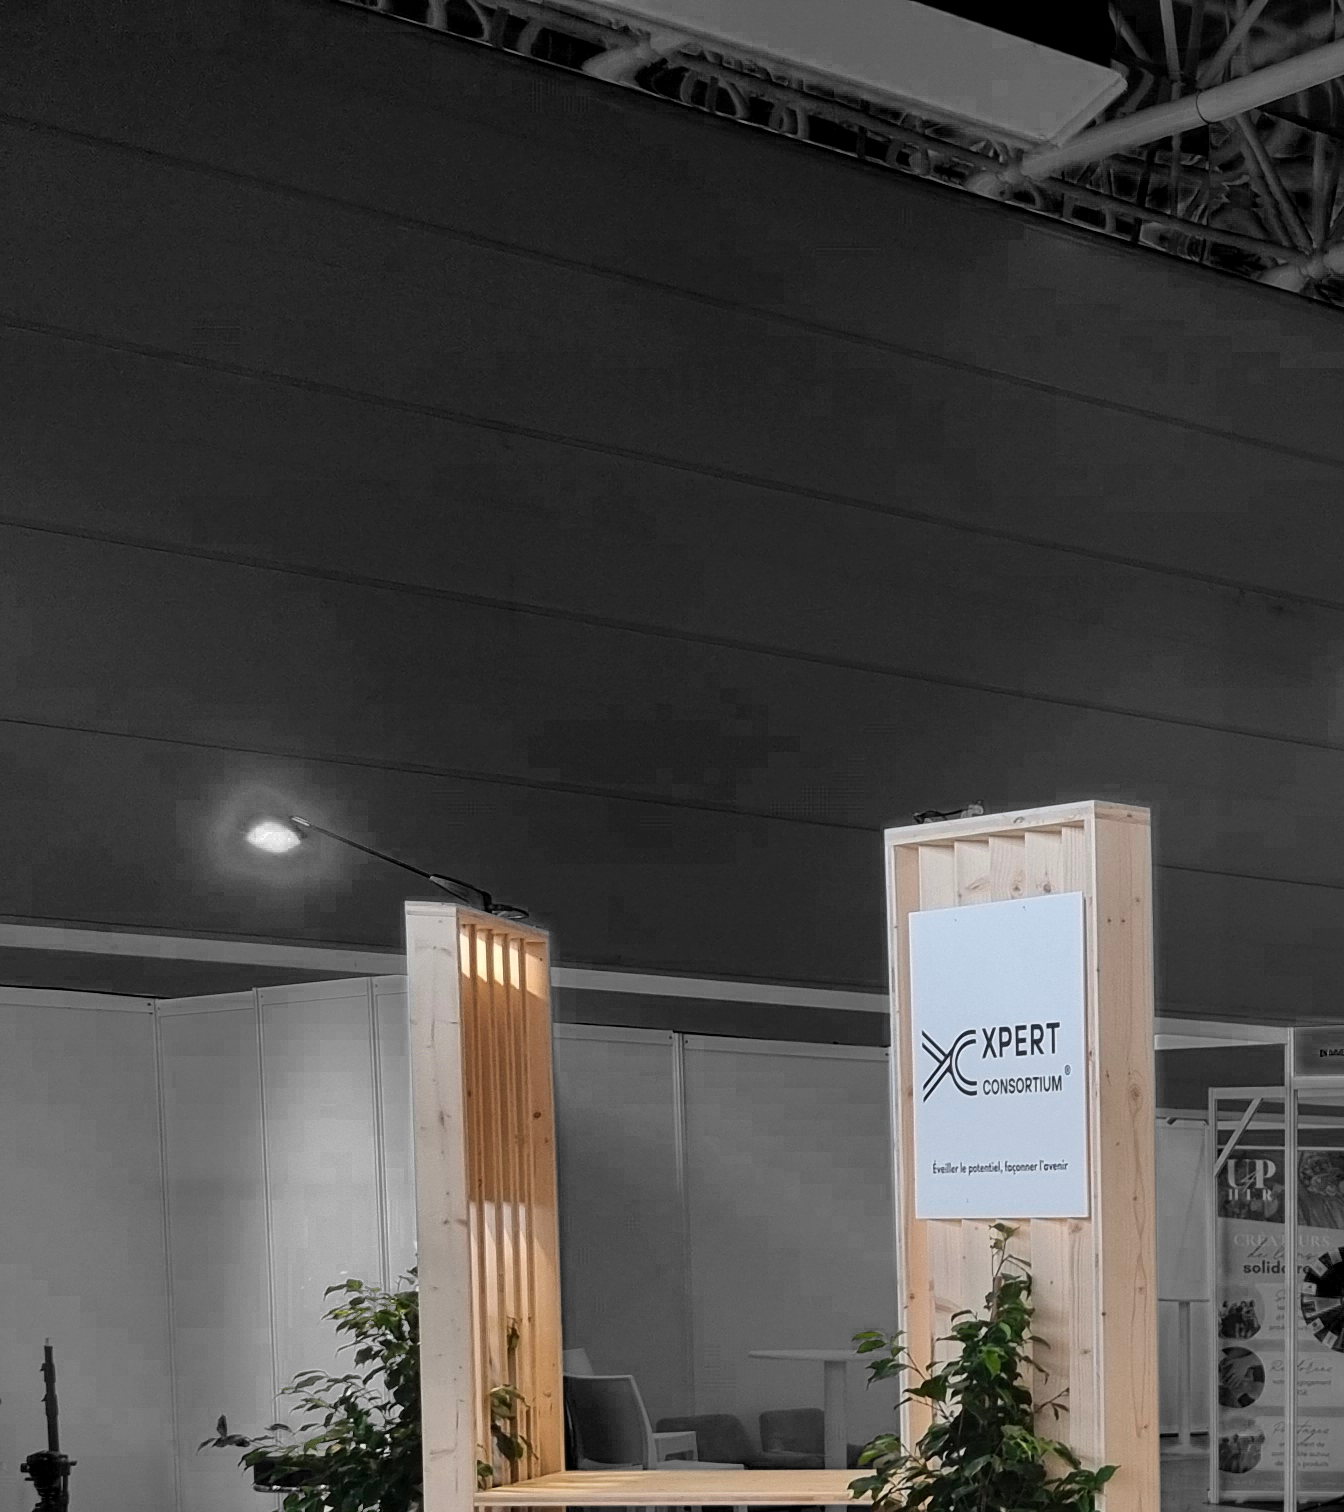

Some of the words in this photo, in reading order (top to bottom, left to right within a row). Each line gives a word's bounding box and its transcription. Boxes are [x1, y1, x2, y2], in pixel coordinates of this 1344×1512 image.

[981, 1022, 1060, 1059] XPERT
[982, 1076, 1063, 1096] CONSORTIUM
[960, 1161, 967, 1173] le
